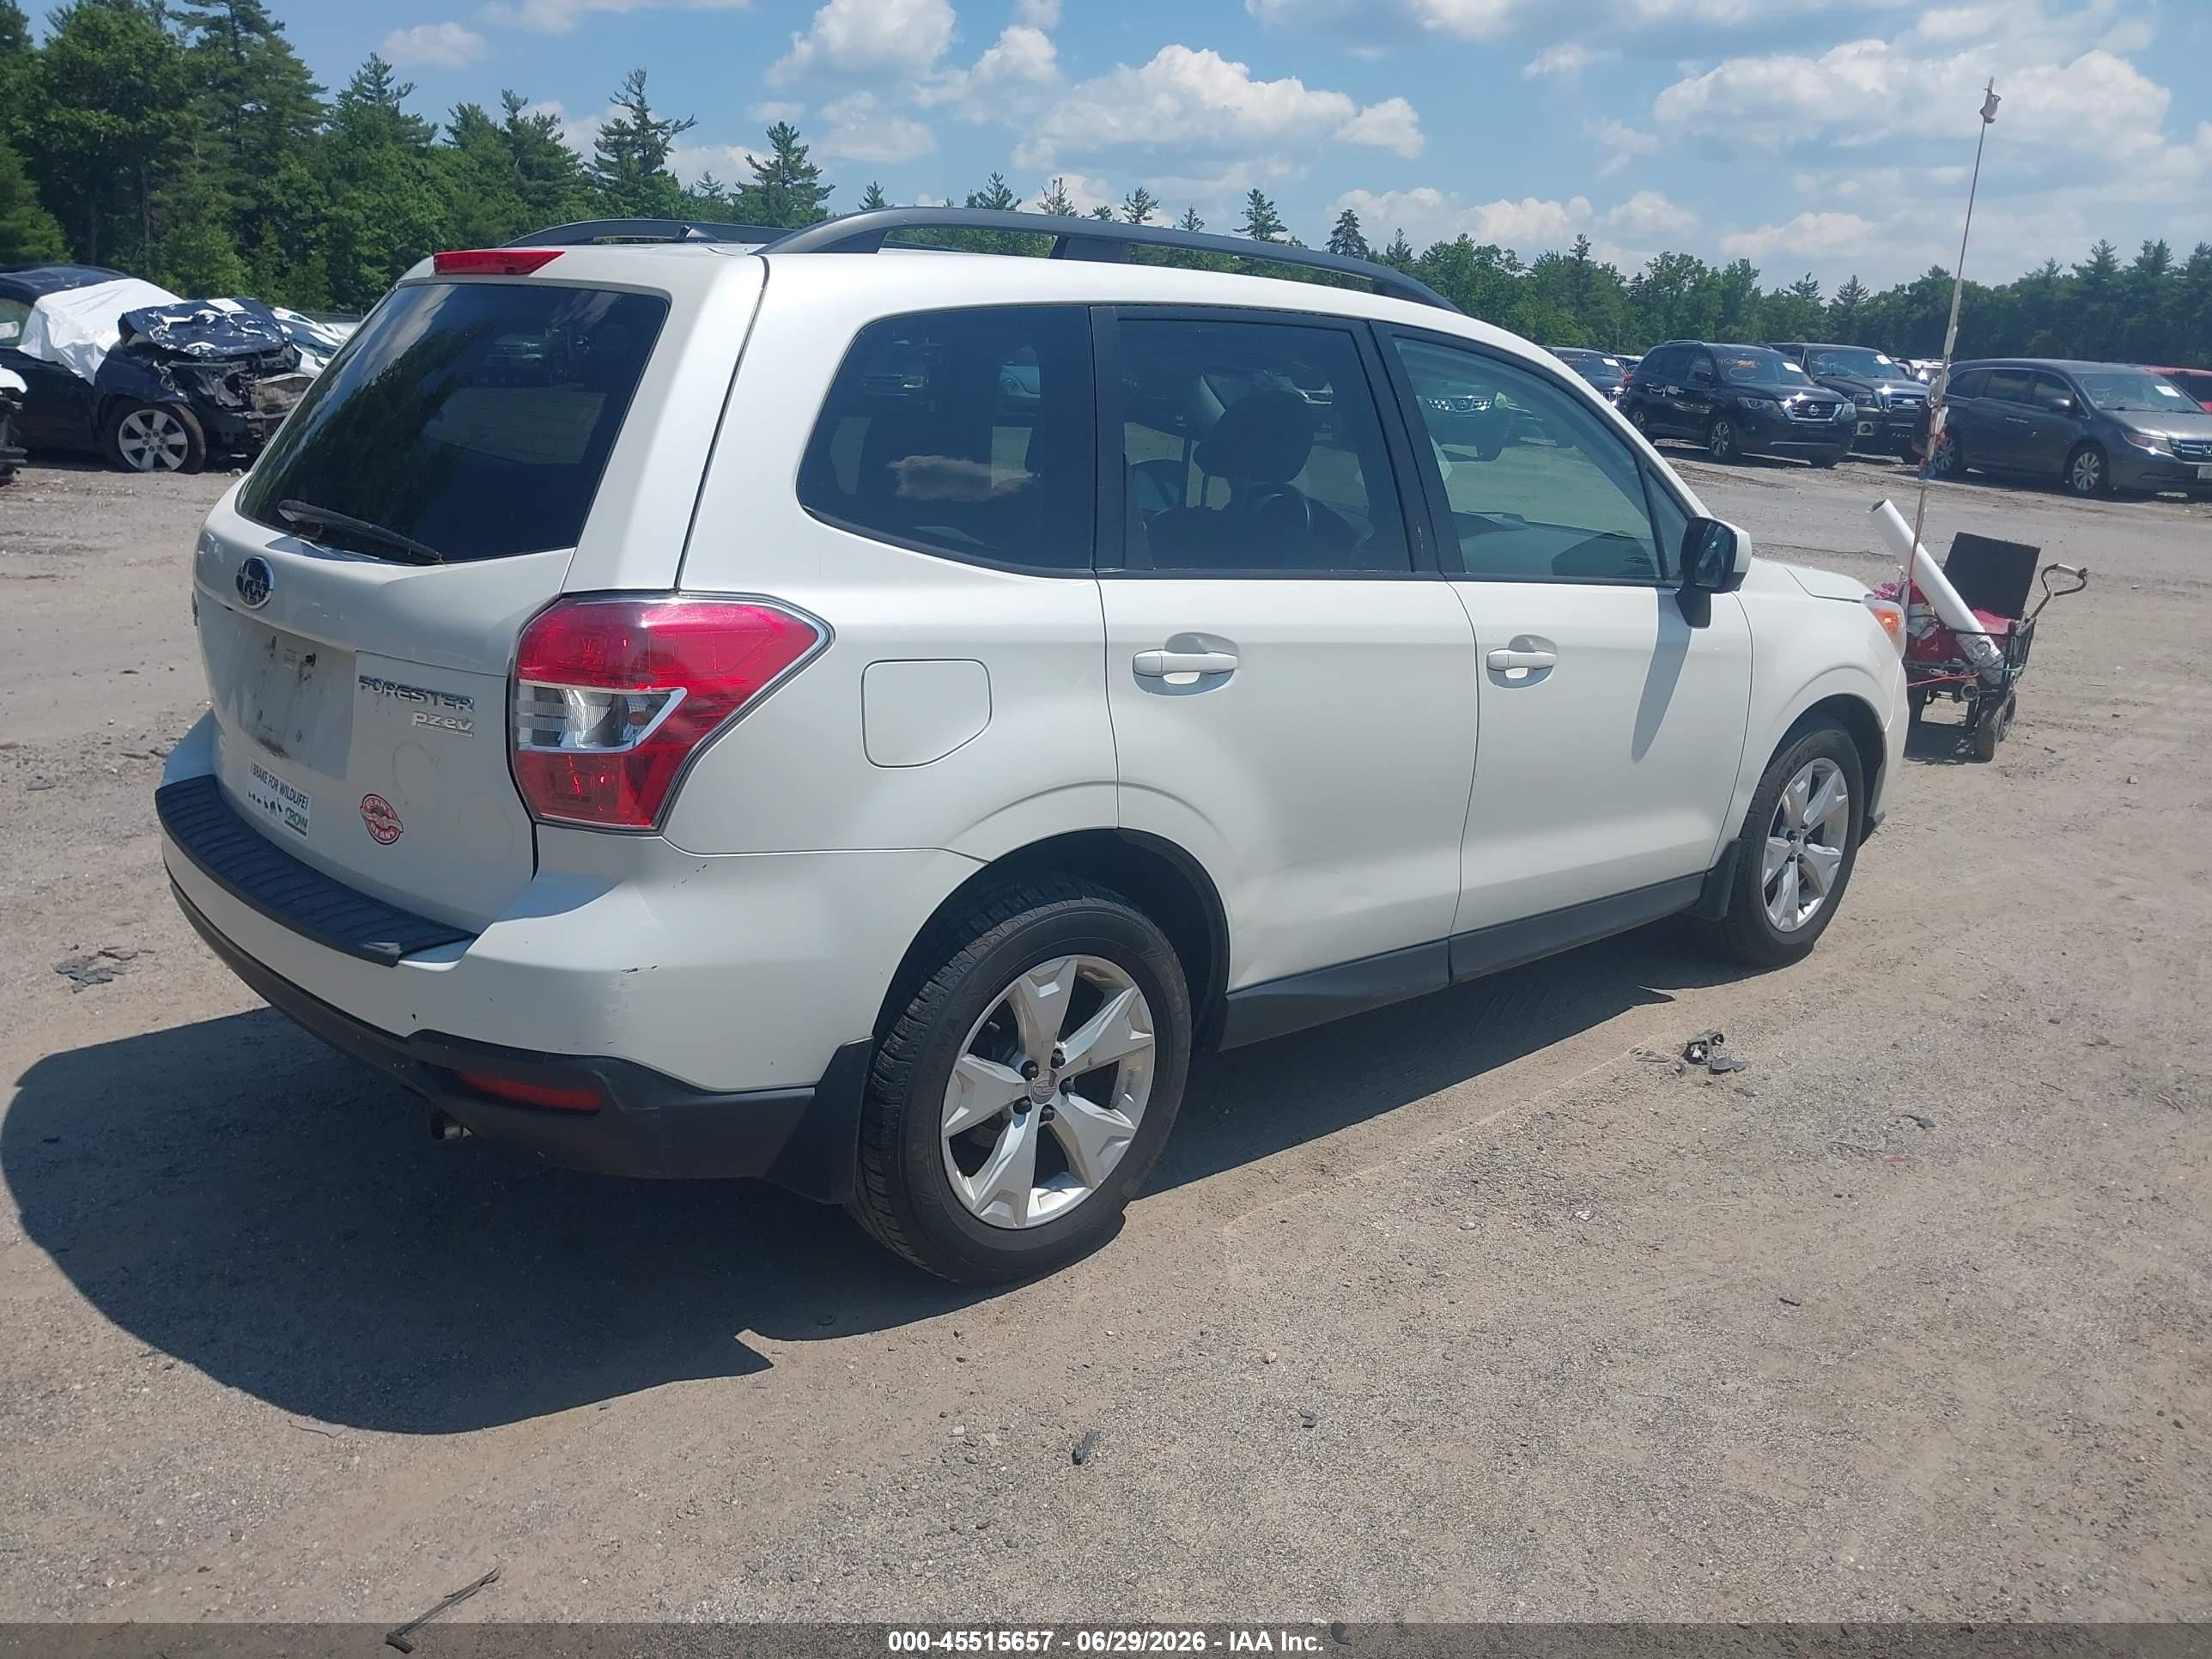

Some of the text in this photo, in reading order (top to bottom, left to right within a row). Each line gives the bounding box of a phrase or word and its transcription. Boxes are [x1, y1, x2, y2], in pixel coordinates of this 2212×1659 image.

[358, 674, 475, 713] FORESTER
[252, 762, 269, 784] BRAKE
[268, 774, 279, 793] FOR
[279, 781, 310, 811] WILDLIFE!
[284, 805, 308, 829] CROW
